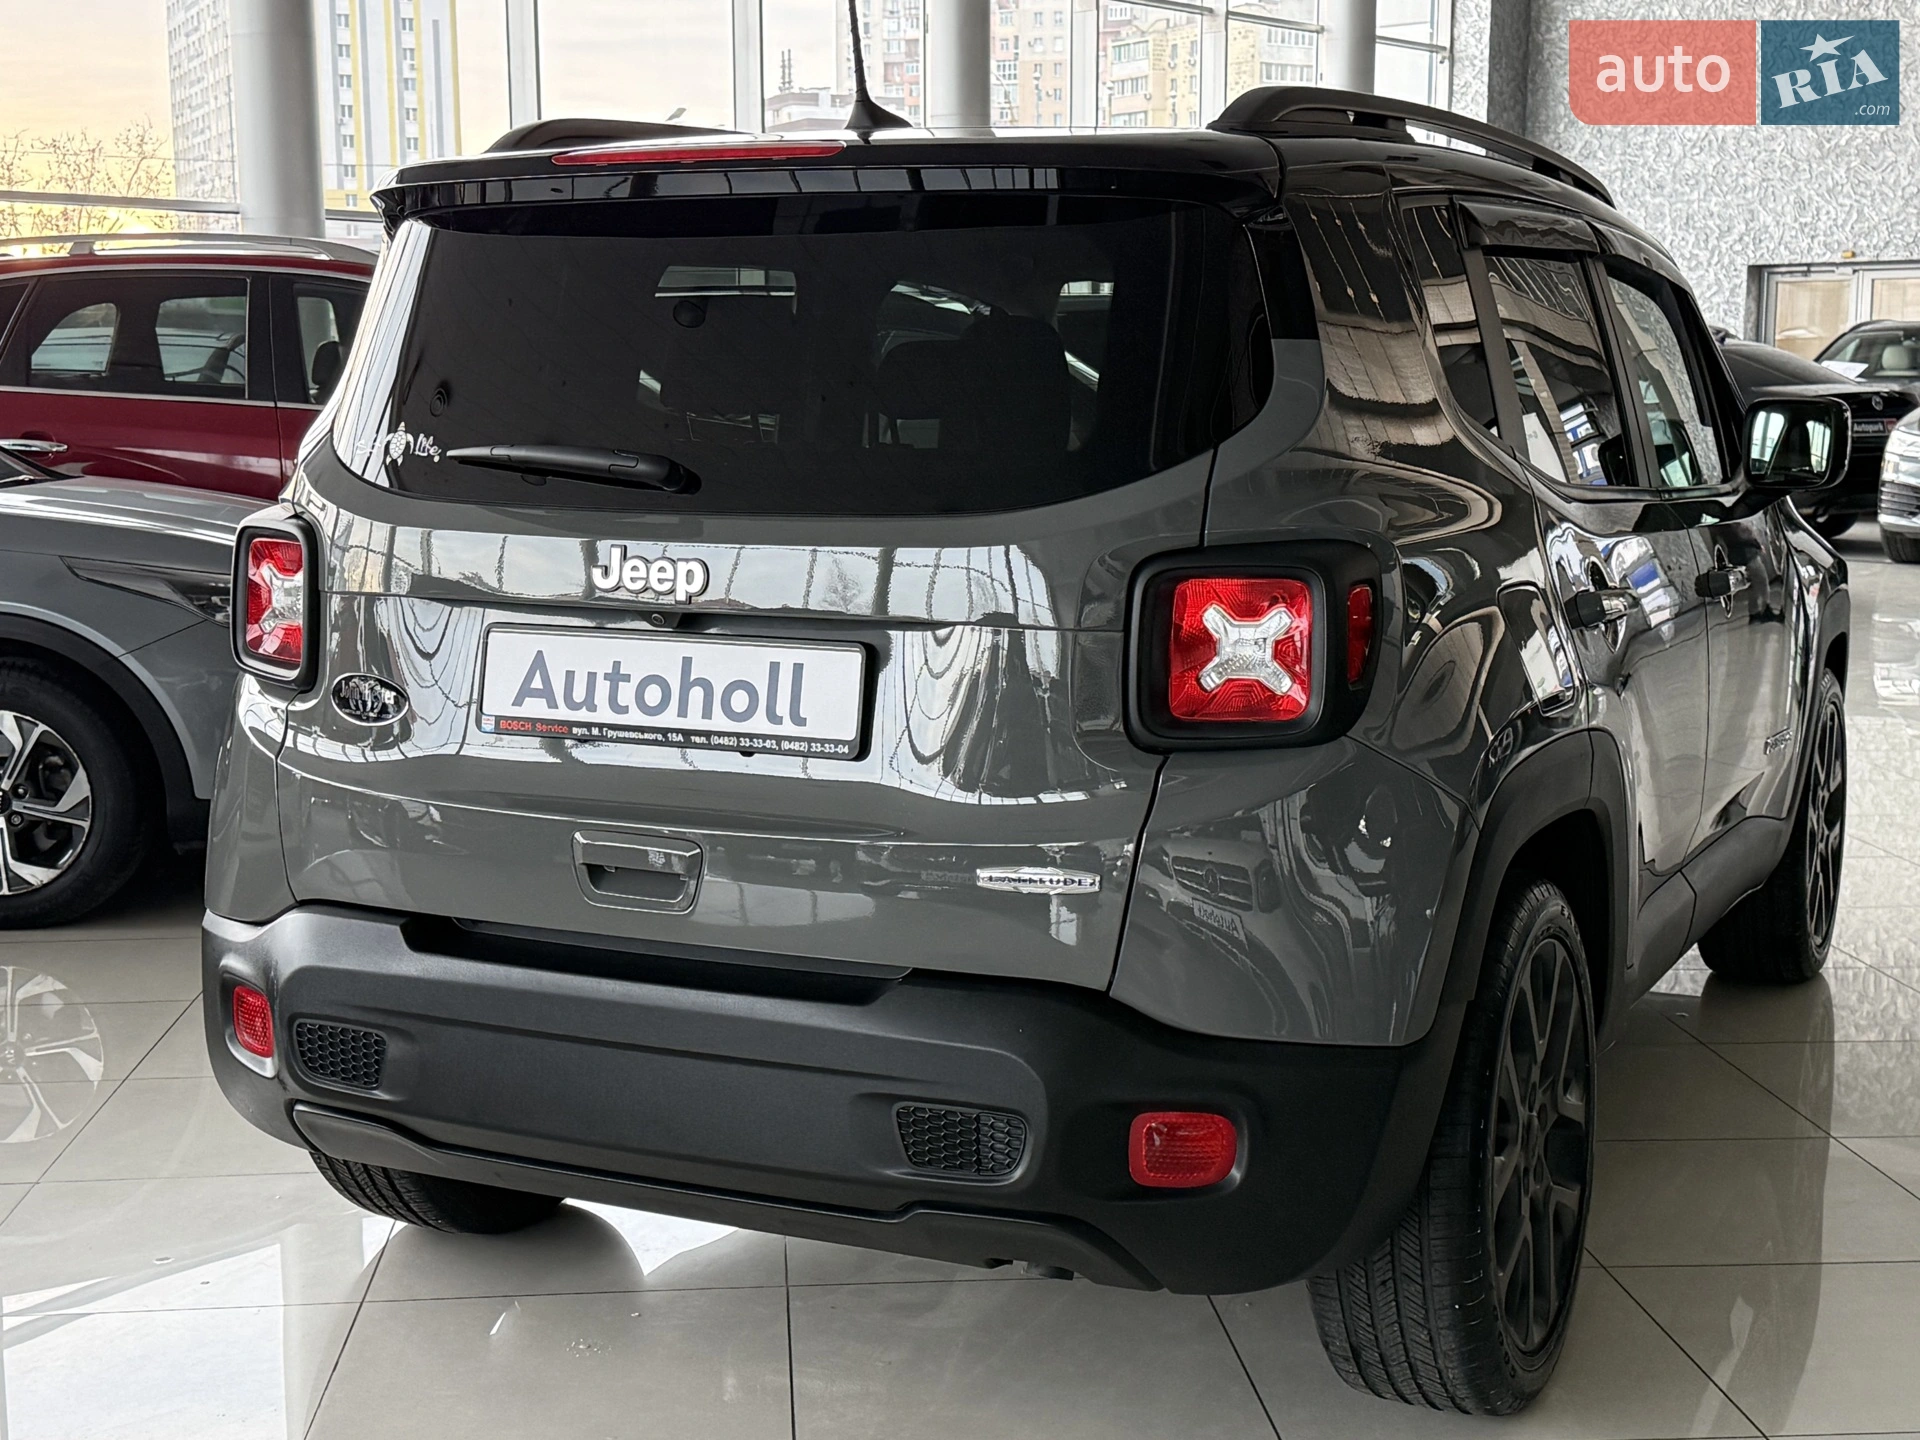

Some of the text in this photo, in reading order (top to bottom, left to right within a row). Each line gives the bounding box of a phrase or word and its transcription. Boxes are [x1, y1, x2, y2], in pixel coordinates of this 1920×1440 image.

[591, 545, 709, 604] Jeep
[511, 650, 807, 727] Autoholl
[500, 720, 532, 731] BOSCH
[535, 722, 569, 733] Service
[711, 734, 737, 747] (0482)
[781, 740, 809, 752] (0482)
[810, 743, 849, 754] 33-33-04
